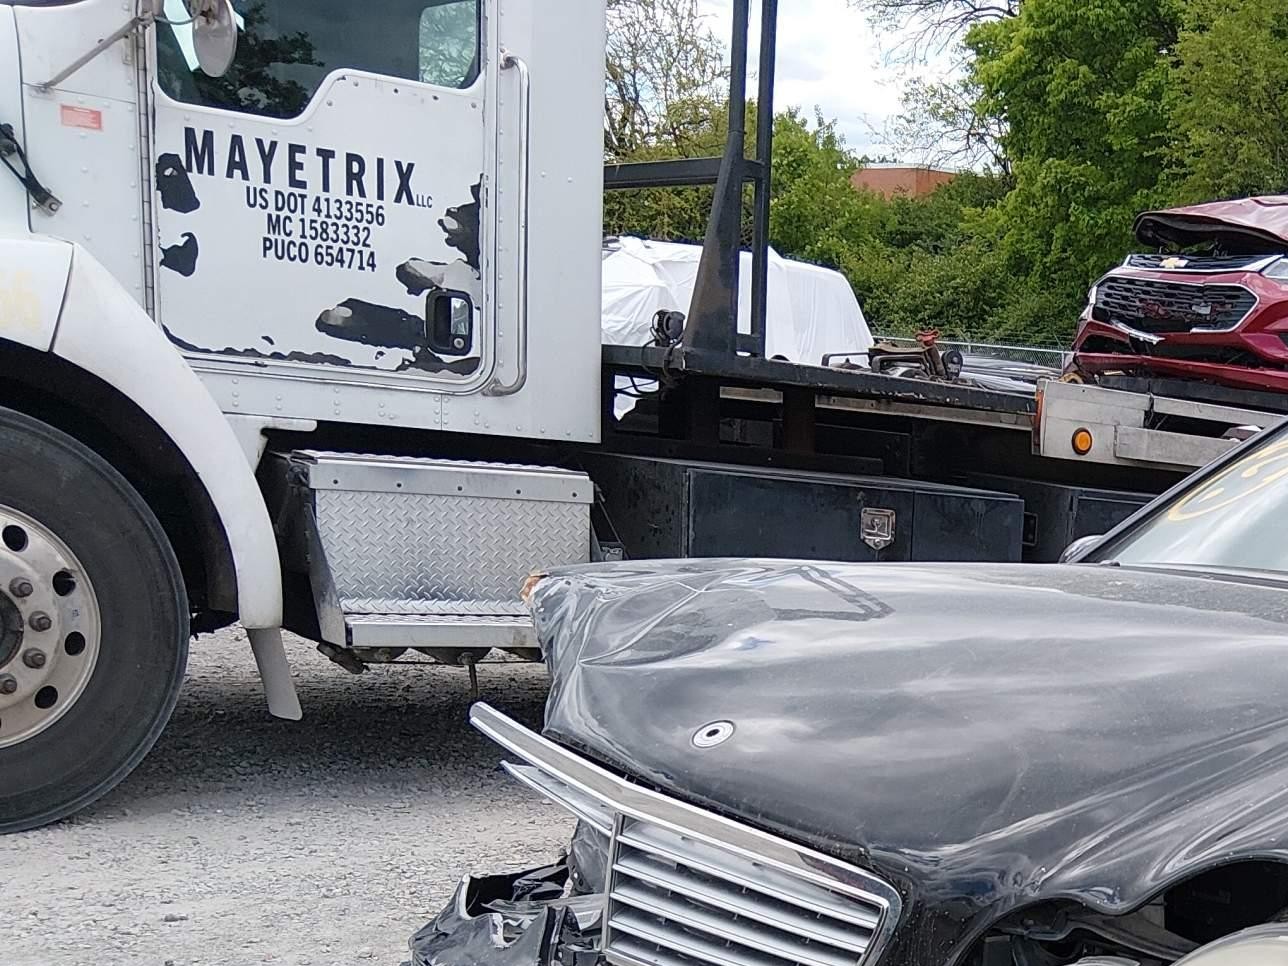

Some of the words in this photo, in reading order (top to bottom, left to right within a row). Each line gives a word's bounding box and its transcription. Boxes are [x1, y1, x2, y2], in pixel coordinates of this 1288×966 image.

[184, 126, 415, 205] MAYETRIX
[416, 193, 433, 209] LLC
[246, 185, 269, 210] US
[274, 189, 307, 216] DOT
[312, 195, 385, 226] 4133556
[266, 213, 293, 237] MC
[299, 217, 371, 247] 1583332
[262, 236, 309, 264] PUCO
[314, 244, 376, 272] 654714
